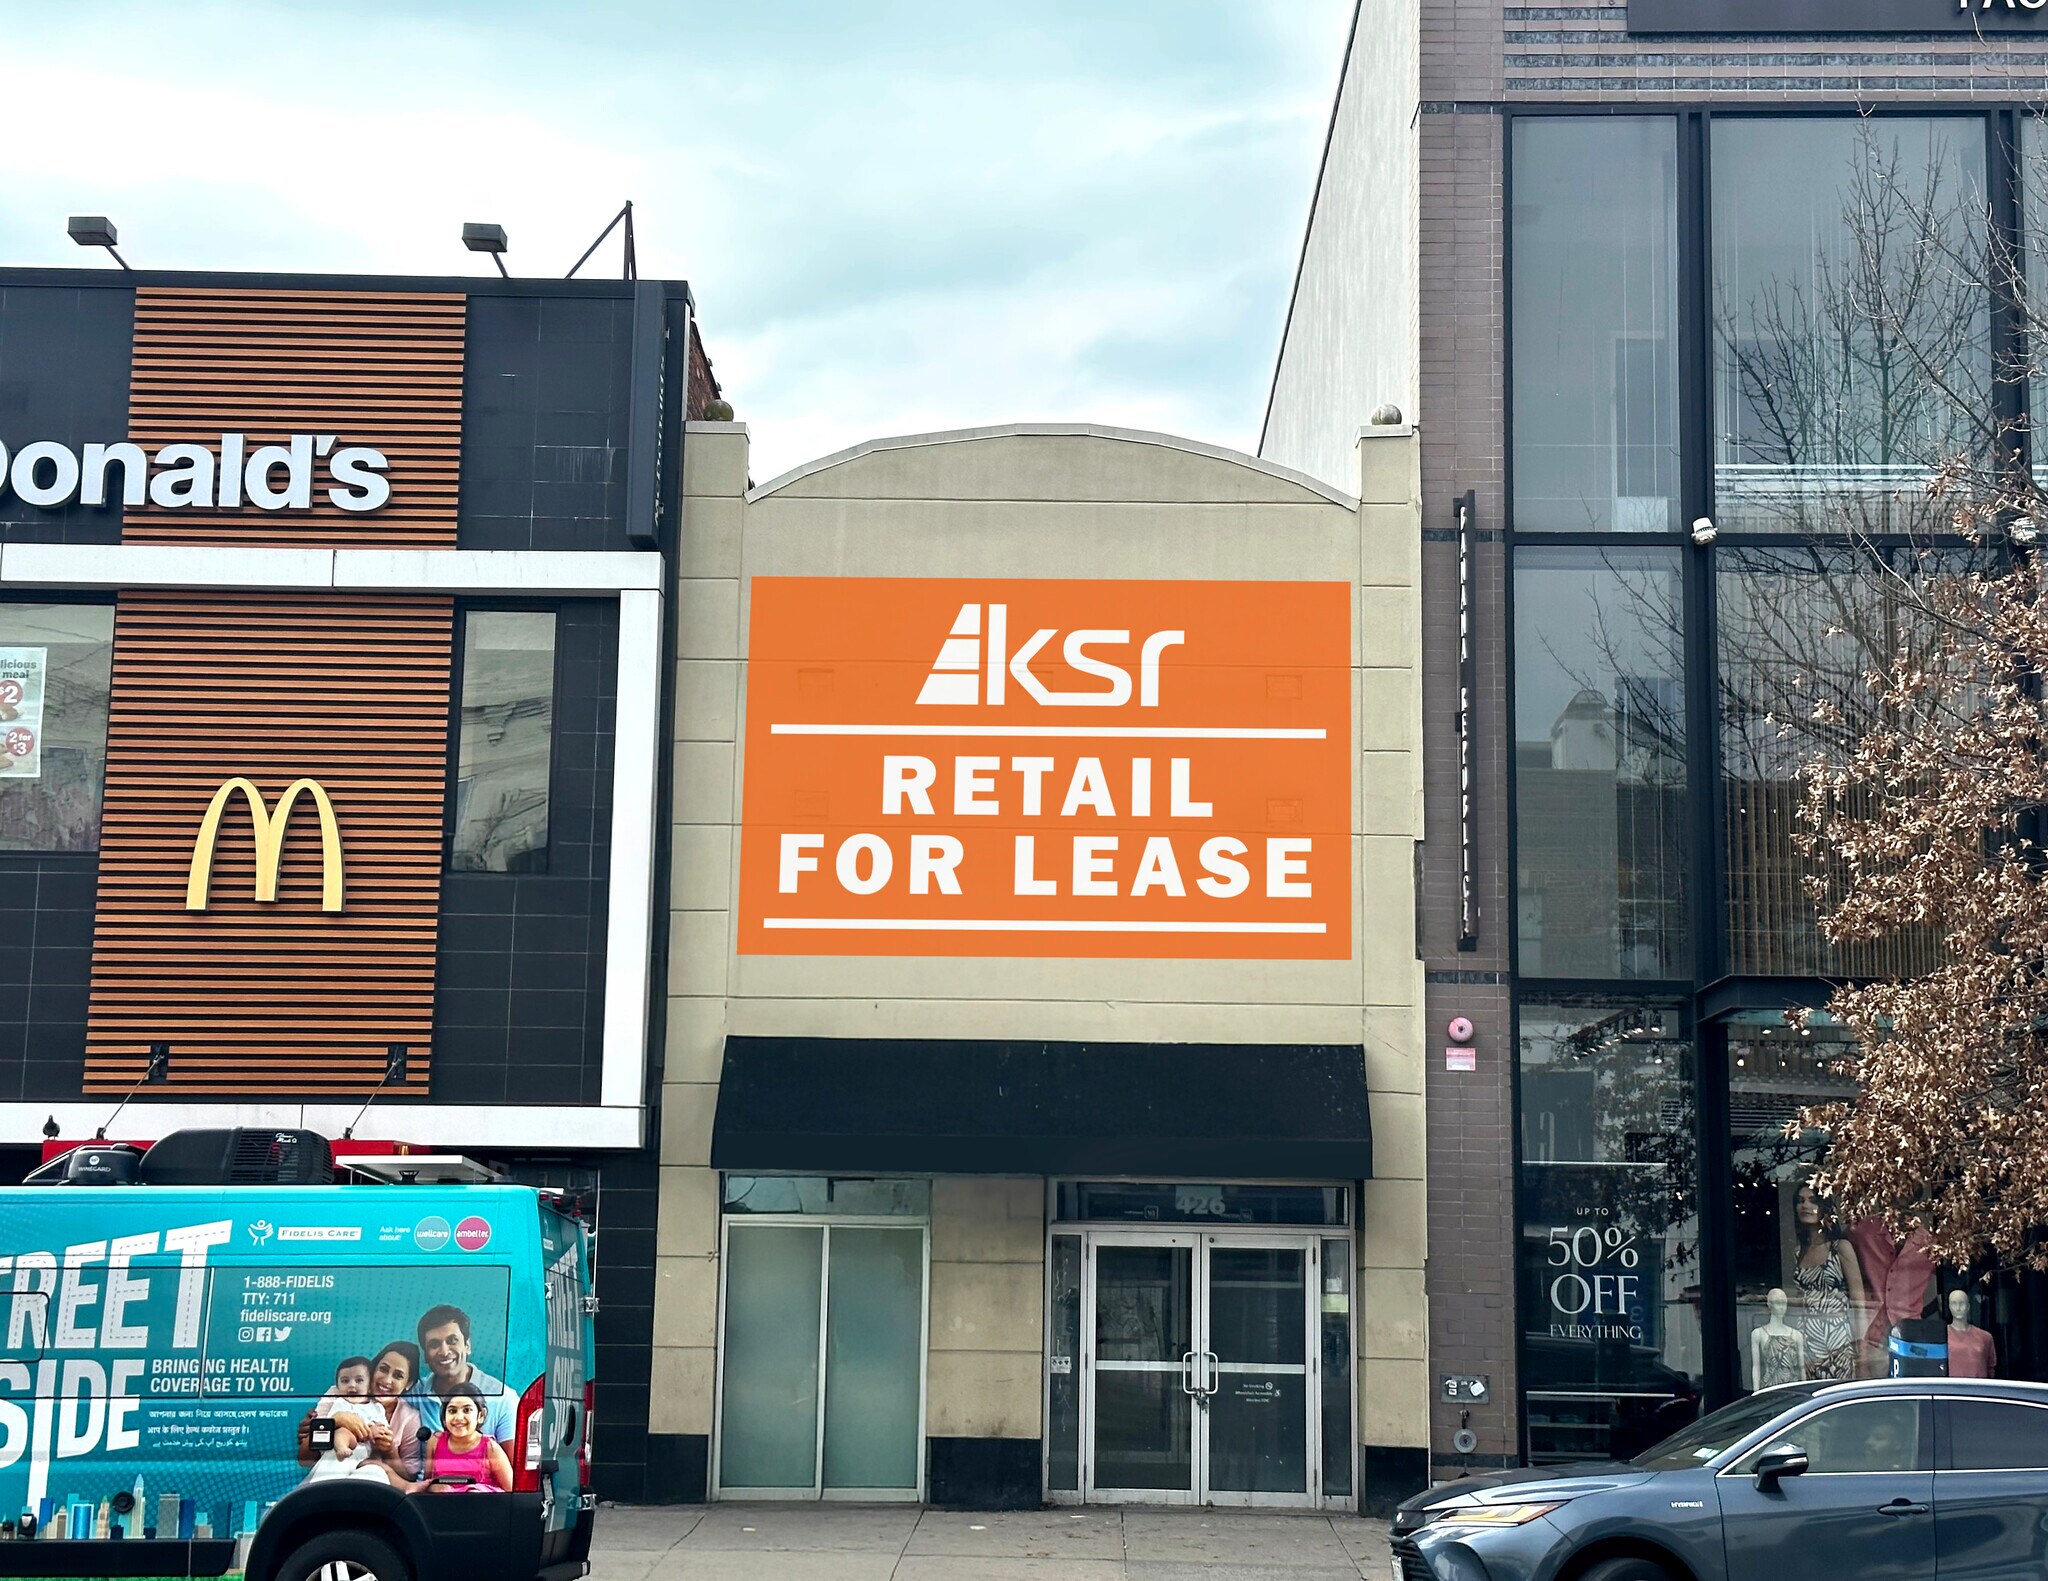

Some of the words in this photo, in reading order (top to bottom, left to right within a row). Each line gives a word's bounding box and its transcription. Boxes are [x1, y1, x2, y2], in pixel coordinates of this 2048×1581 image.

[0, 433, 391, 512] onald's
[0, 660, 37, 669] licious
[2, 670, 30, 679] meal
[9, 732, 17, 743] 2
[882, 755, 1213, 817] RETAIL
[778, 833, 965, 895] FOR
[1014, 835, 1313, 899] LEASE
[1177, 1196, 1226, 1215] 426
[1576, 1207, 1590, 1215] UP
[1594, 1207, 1609, 1215] TO
[416, 1229, 449, 1238] wellcare
[1547, 1226, 1639, 1268] 50%
[244, 1275, 335, 1289] 1-888-FIDELIS
[242, 1292, 270, 1305] TTY:
[273, 1292, 295, 1305] 711
[1550, 1273, 1639, 1315] OFF
[240, 1309, 332, 1324] fideliscare.org
[1550, 1324, 1642, 1339] EVERYTHING
[152, 1358, 226, 1374] BRINGNG
[230, 1358, 289, 1373] HEALTH
[150, 1377, 232, 1393] COVERAGE
[236, 1377, 255, 1392] TO
[260, 1377, 295, 1392] YOU.
